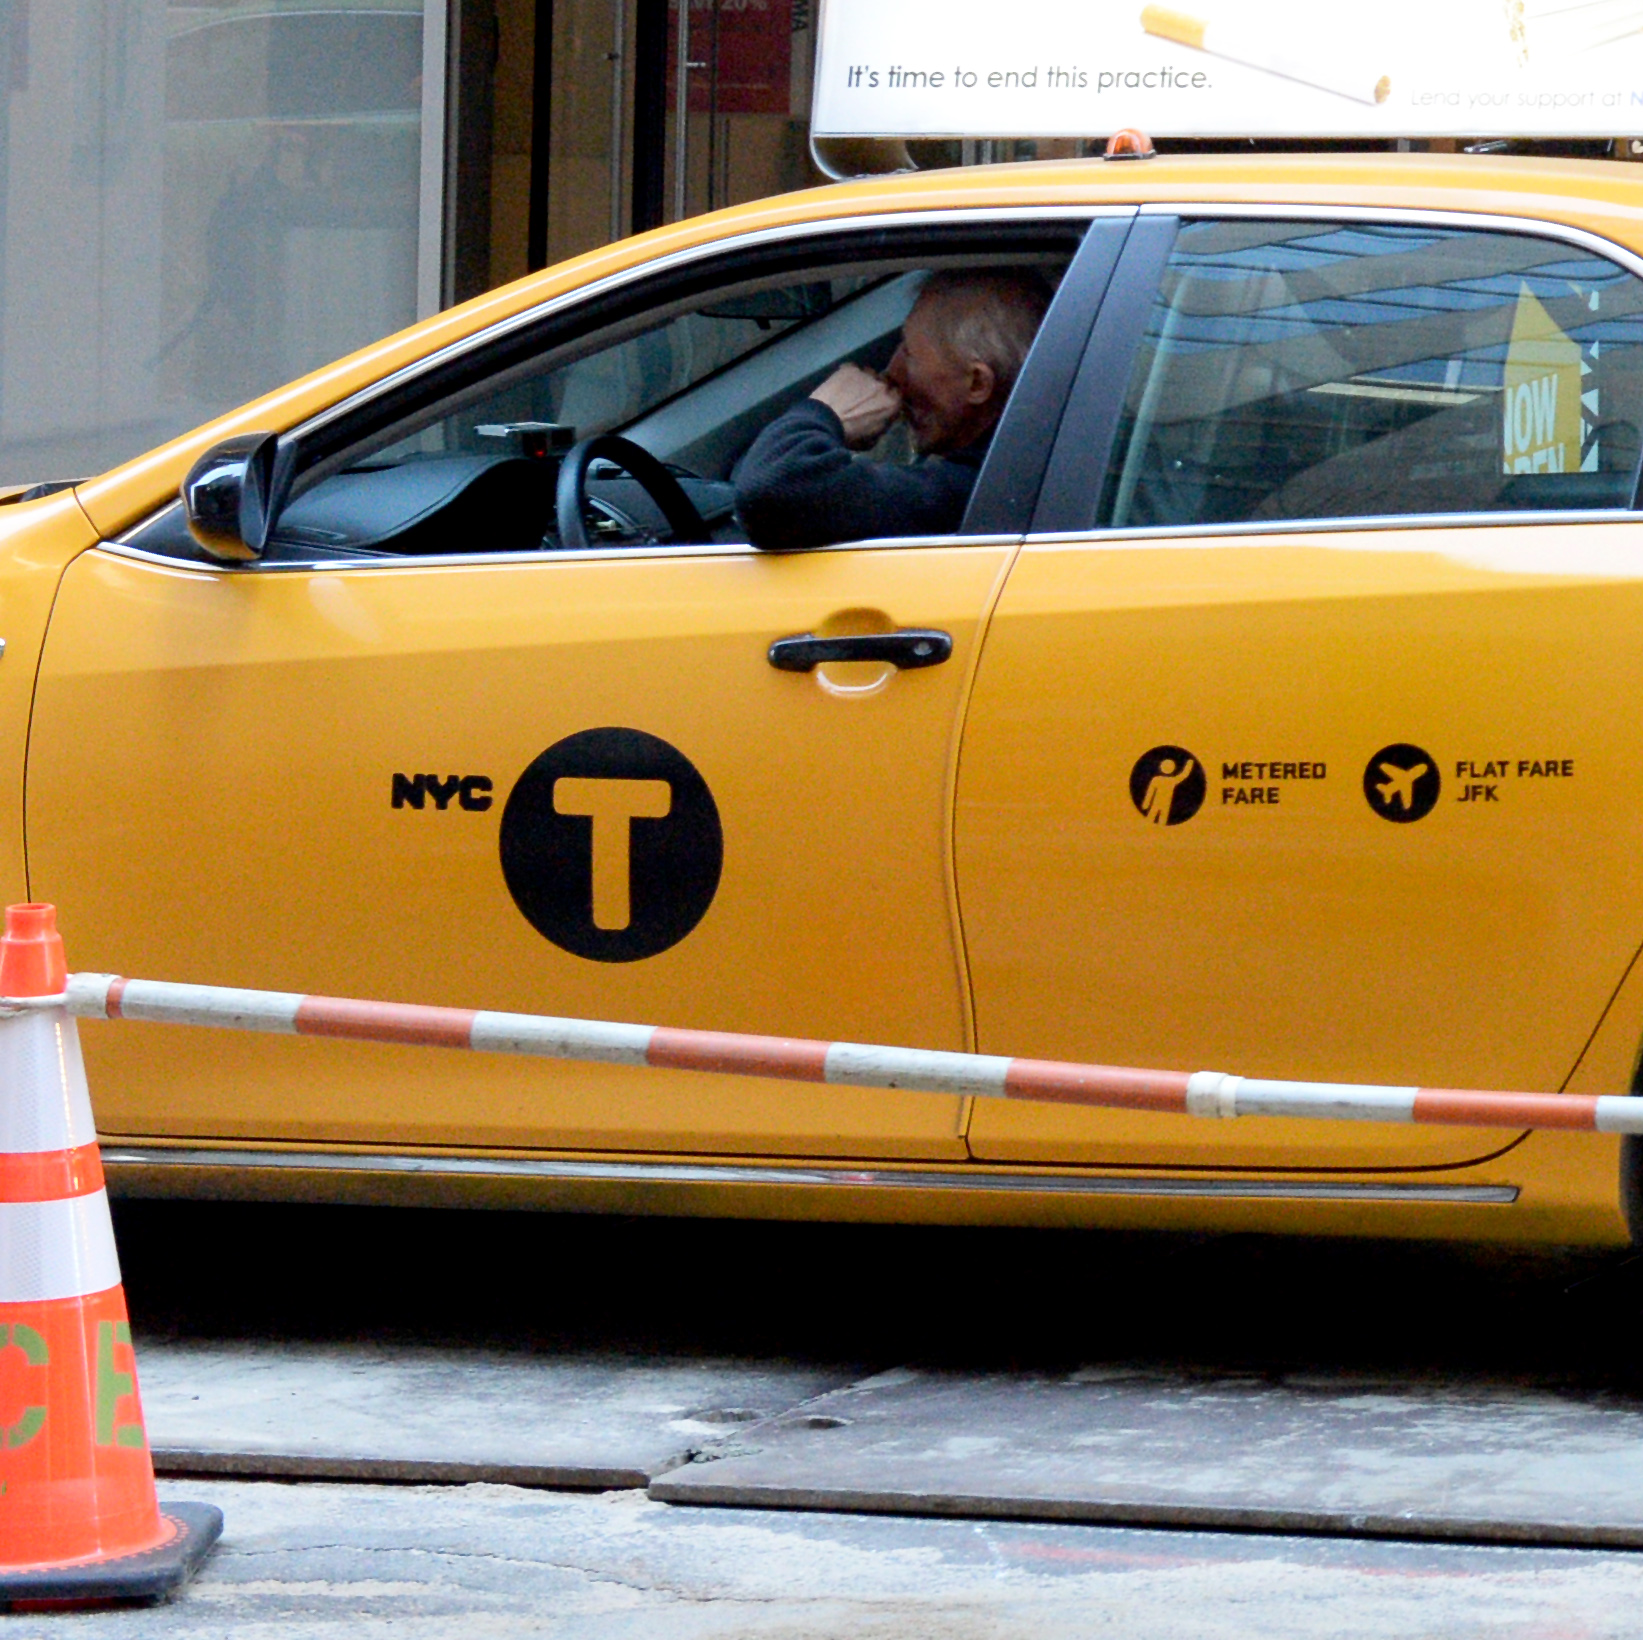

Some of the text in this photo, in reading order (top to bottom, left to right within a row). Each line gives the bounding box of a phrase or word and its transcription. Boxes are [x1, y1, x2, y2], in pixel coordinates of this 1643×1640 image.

[847, 65, 1214, 94] It's time to end this practice.
[1411, 89, 1460, 106] Lend
[1468, 92, 1510, 110] your
[1517, 90, 1595, 109] support
[1602, 90, 1622, 107] at
[1222, 762, 1327, 780] METERED
[1456, 760, 1574, 778] FLAT FARE
[391, 772, 493, 812] NYC
[1222, 787, 1280, 804] FARE
[1457, 785, 1499, 802] JFK
